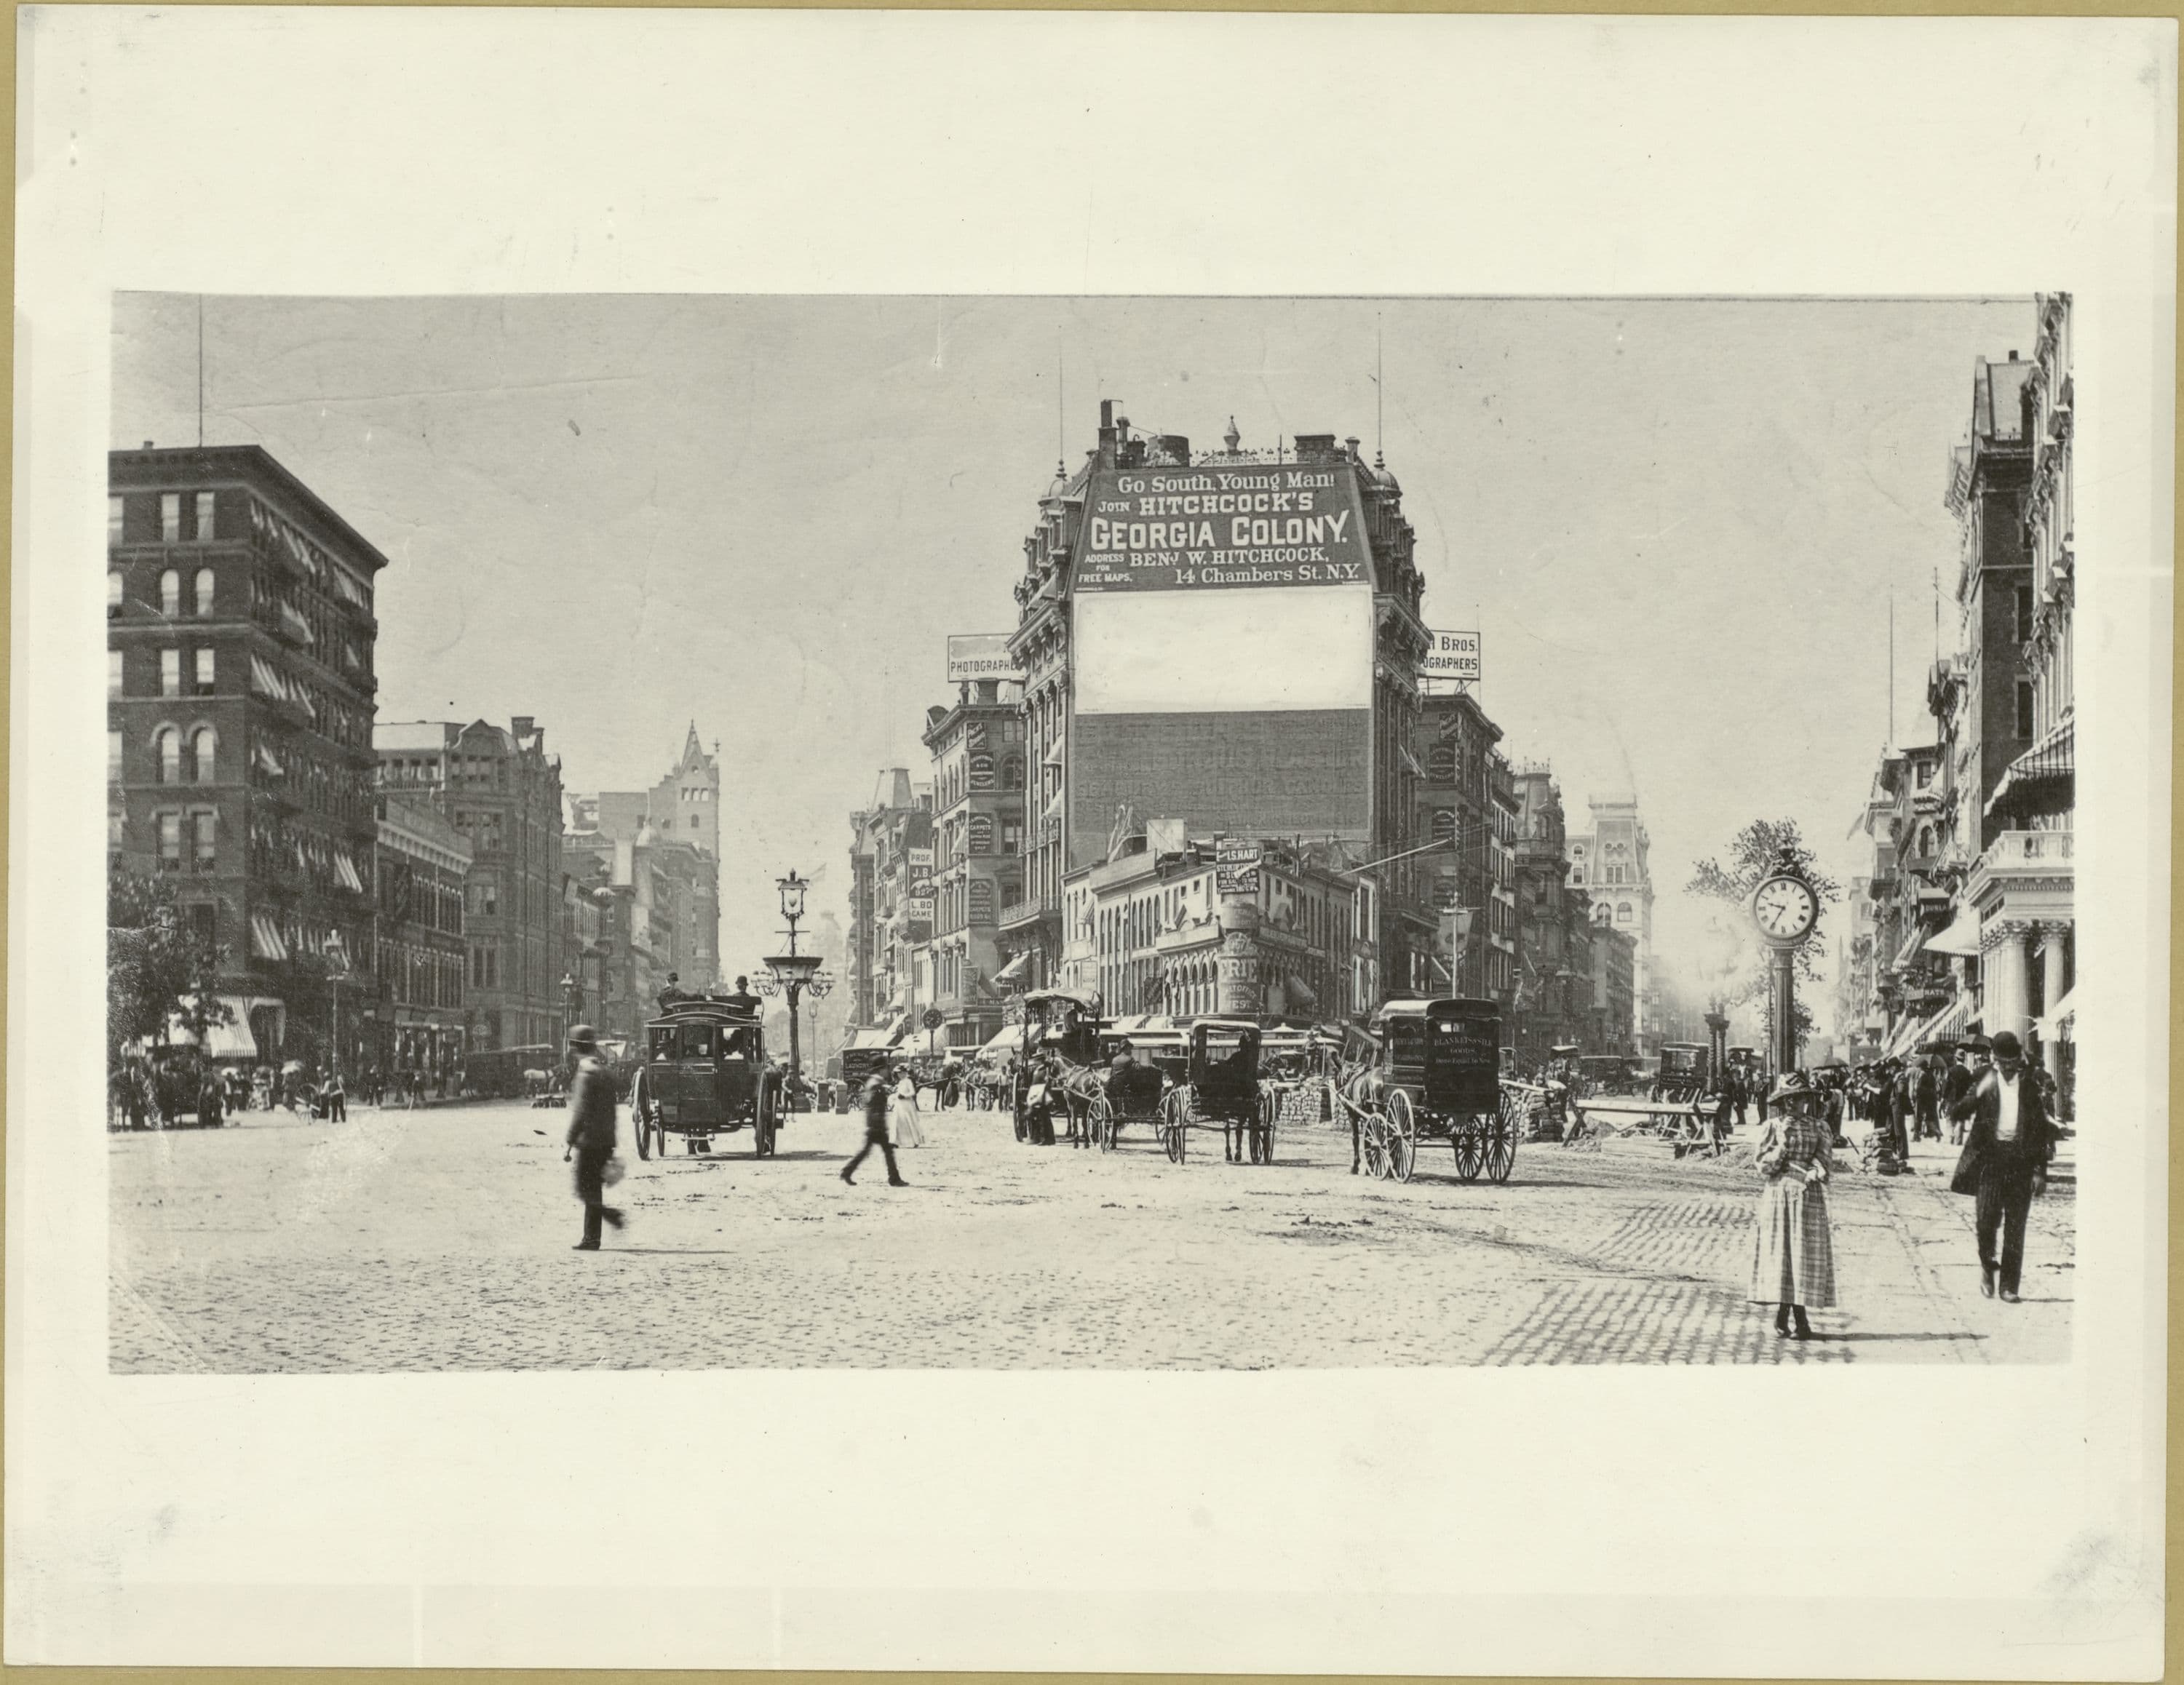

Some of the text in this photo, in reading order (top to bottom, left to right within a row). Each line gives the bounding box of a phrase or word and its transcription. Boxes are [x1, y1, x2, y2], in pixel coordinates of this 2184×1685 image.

[1118, 471, 1334, 493] Go South, Young Man!
[1139, 492, 1314, 516] HITCHCOCK'S
[1091, 509, 1350, 551] GEORGIA COLONY.
[1084, 554, 1124, 563] ADDRESS
[1186, 551, 1207, 565] W.
[1211, 546, 1329, 565] HITCHCOCK,
[1079, 573, 1133, 583] FREE MAPS.
[1175, 563, 1362, 583] 14 Chambers St. N.Y.
[1442, 637, 1478, 651] BROS.
[911, 854, 932, 862] PROF.
[1220, 957, 1258, 983] ERIE
